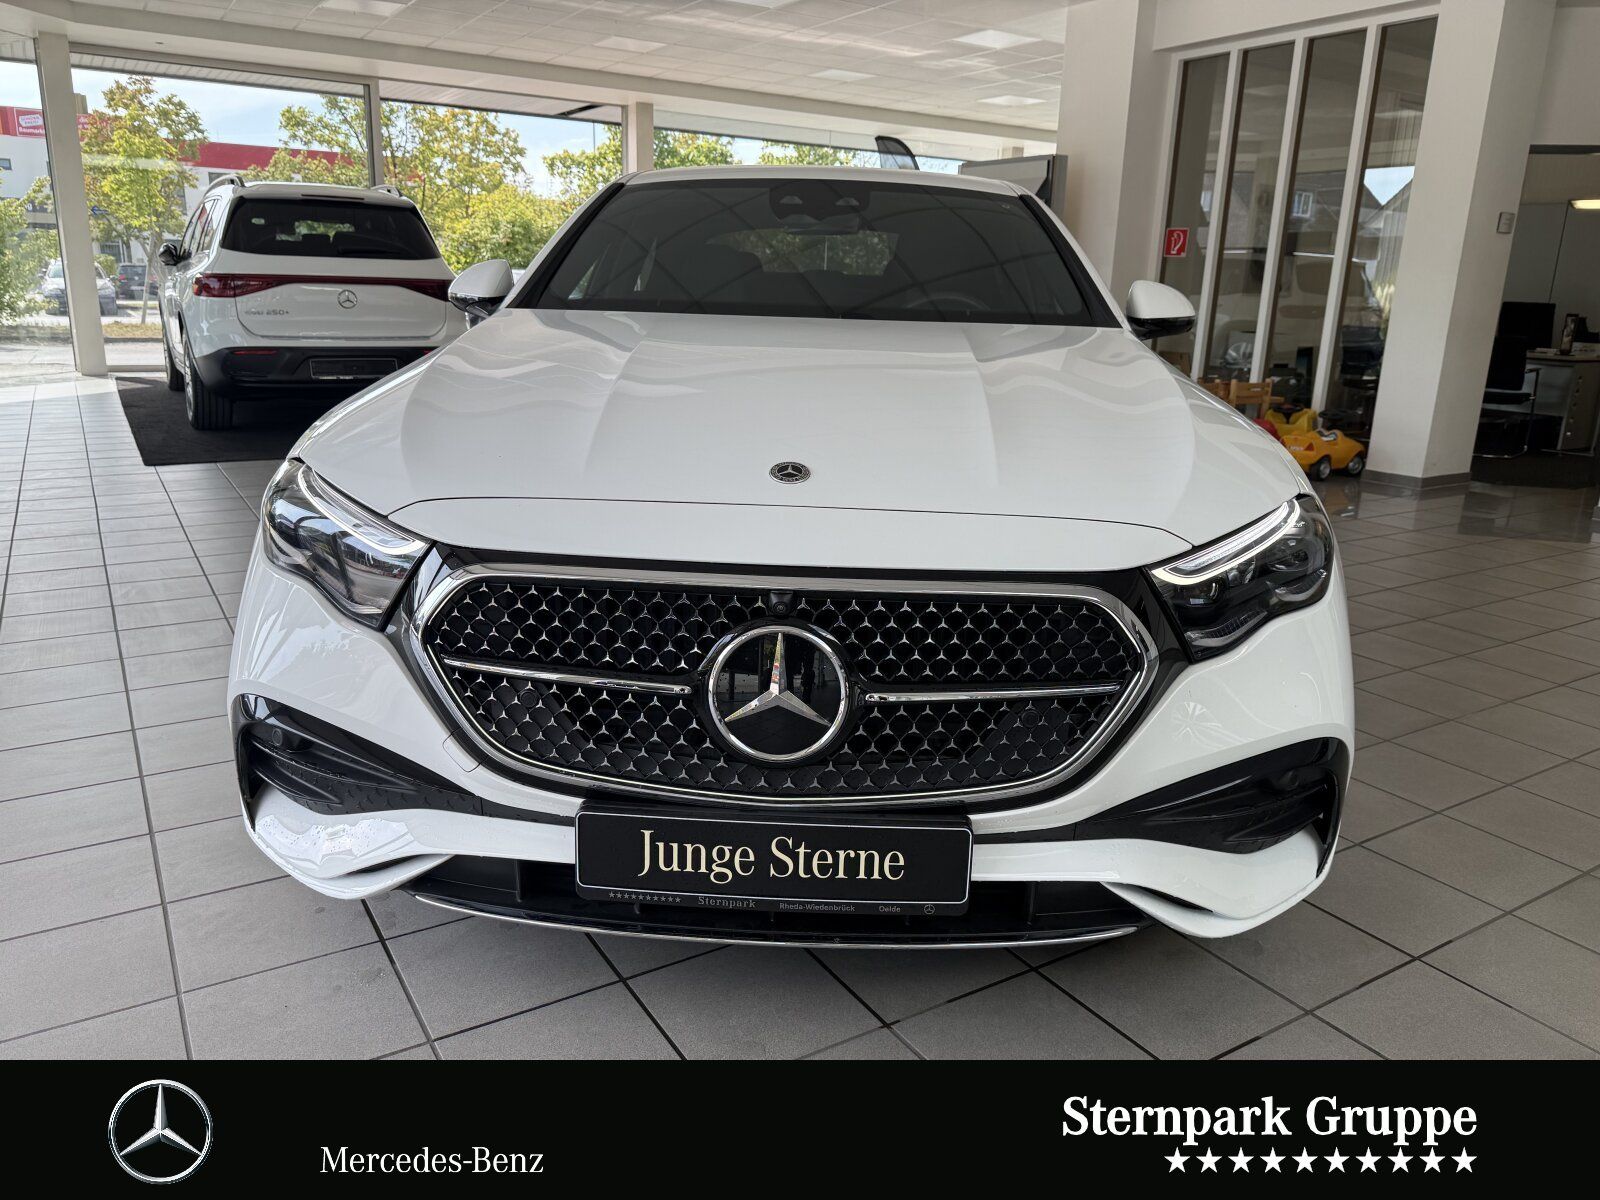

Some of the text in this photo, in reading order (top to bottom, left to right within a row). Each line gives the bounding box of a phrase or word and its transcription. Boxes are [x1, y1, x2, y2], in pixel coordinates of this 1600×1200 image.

[637, 829, 905, 885] Junge Sterne
[698, 896, 901, 913] Sternpark Rheda-Wiedenbrück Oelde
